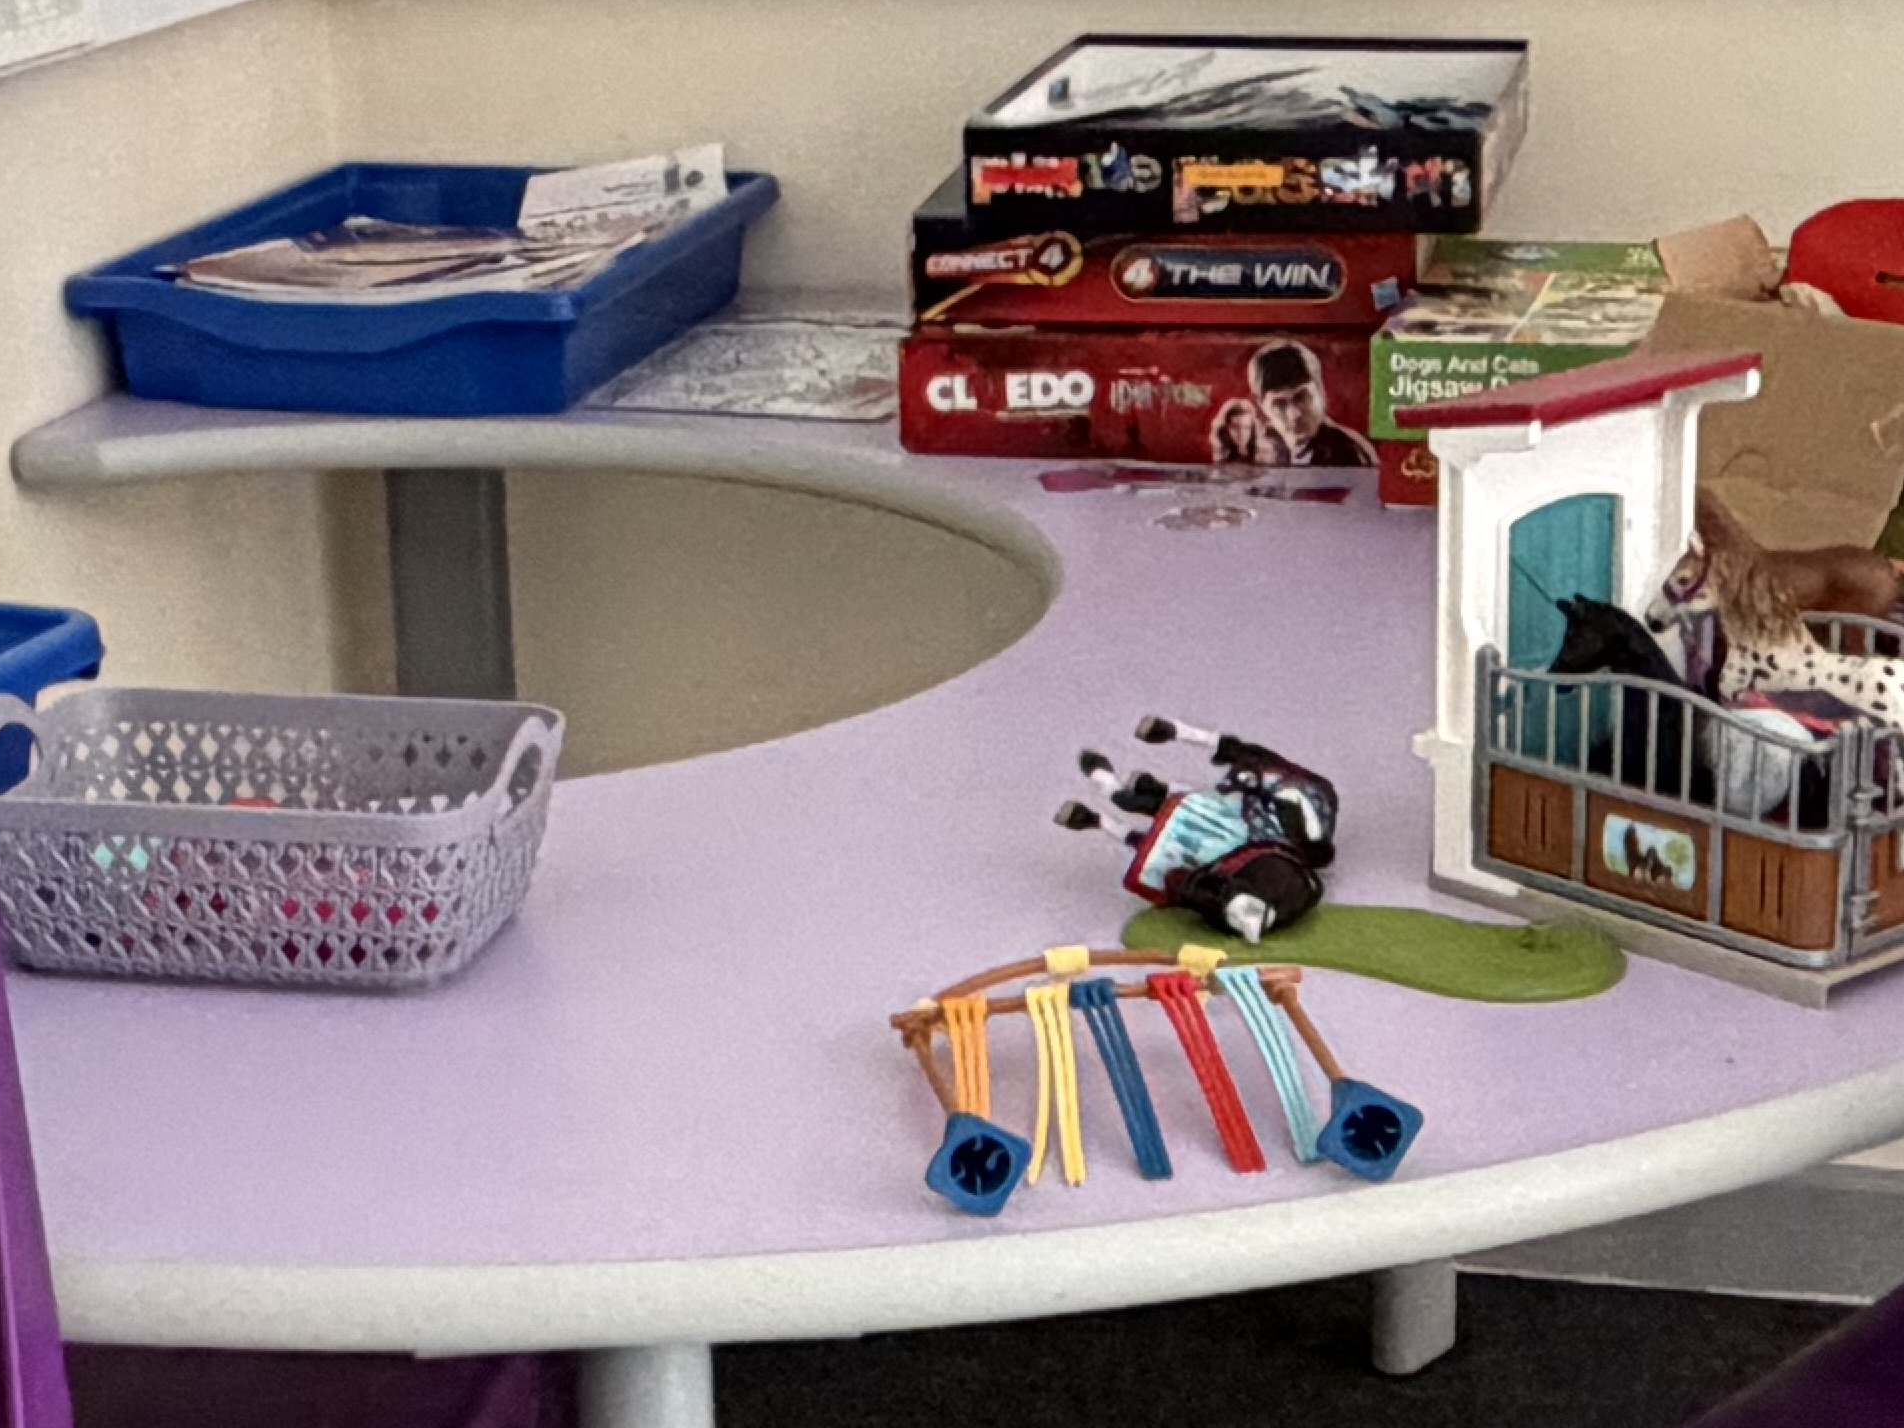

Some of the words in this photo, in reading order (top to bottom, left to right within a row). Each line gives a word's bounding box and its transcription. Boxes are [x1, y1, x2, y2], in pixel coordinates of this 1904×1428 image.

[926, 248, 1033, 275] CONNECT
[1039, 243, 1065, 269] 4
[1122, 258, 1154, 289] 4
[1162, 262, 1242, 286] THE
[1253, 262, 1332, 288] WIN
[1391, 353, 1442, 375] Dogs
[1447, 355, 1488, 374] And
[1493, 354, 1540, 374] Cats
[926, 371, 1095, 412] CLEDO
[1389, 375, 1484, 403] Jigsaw
